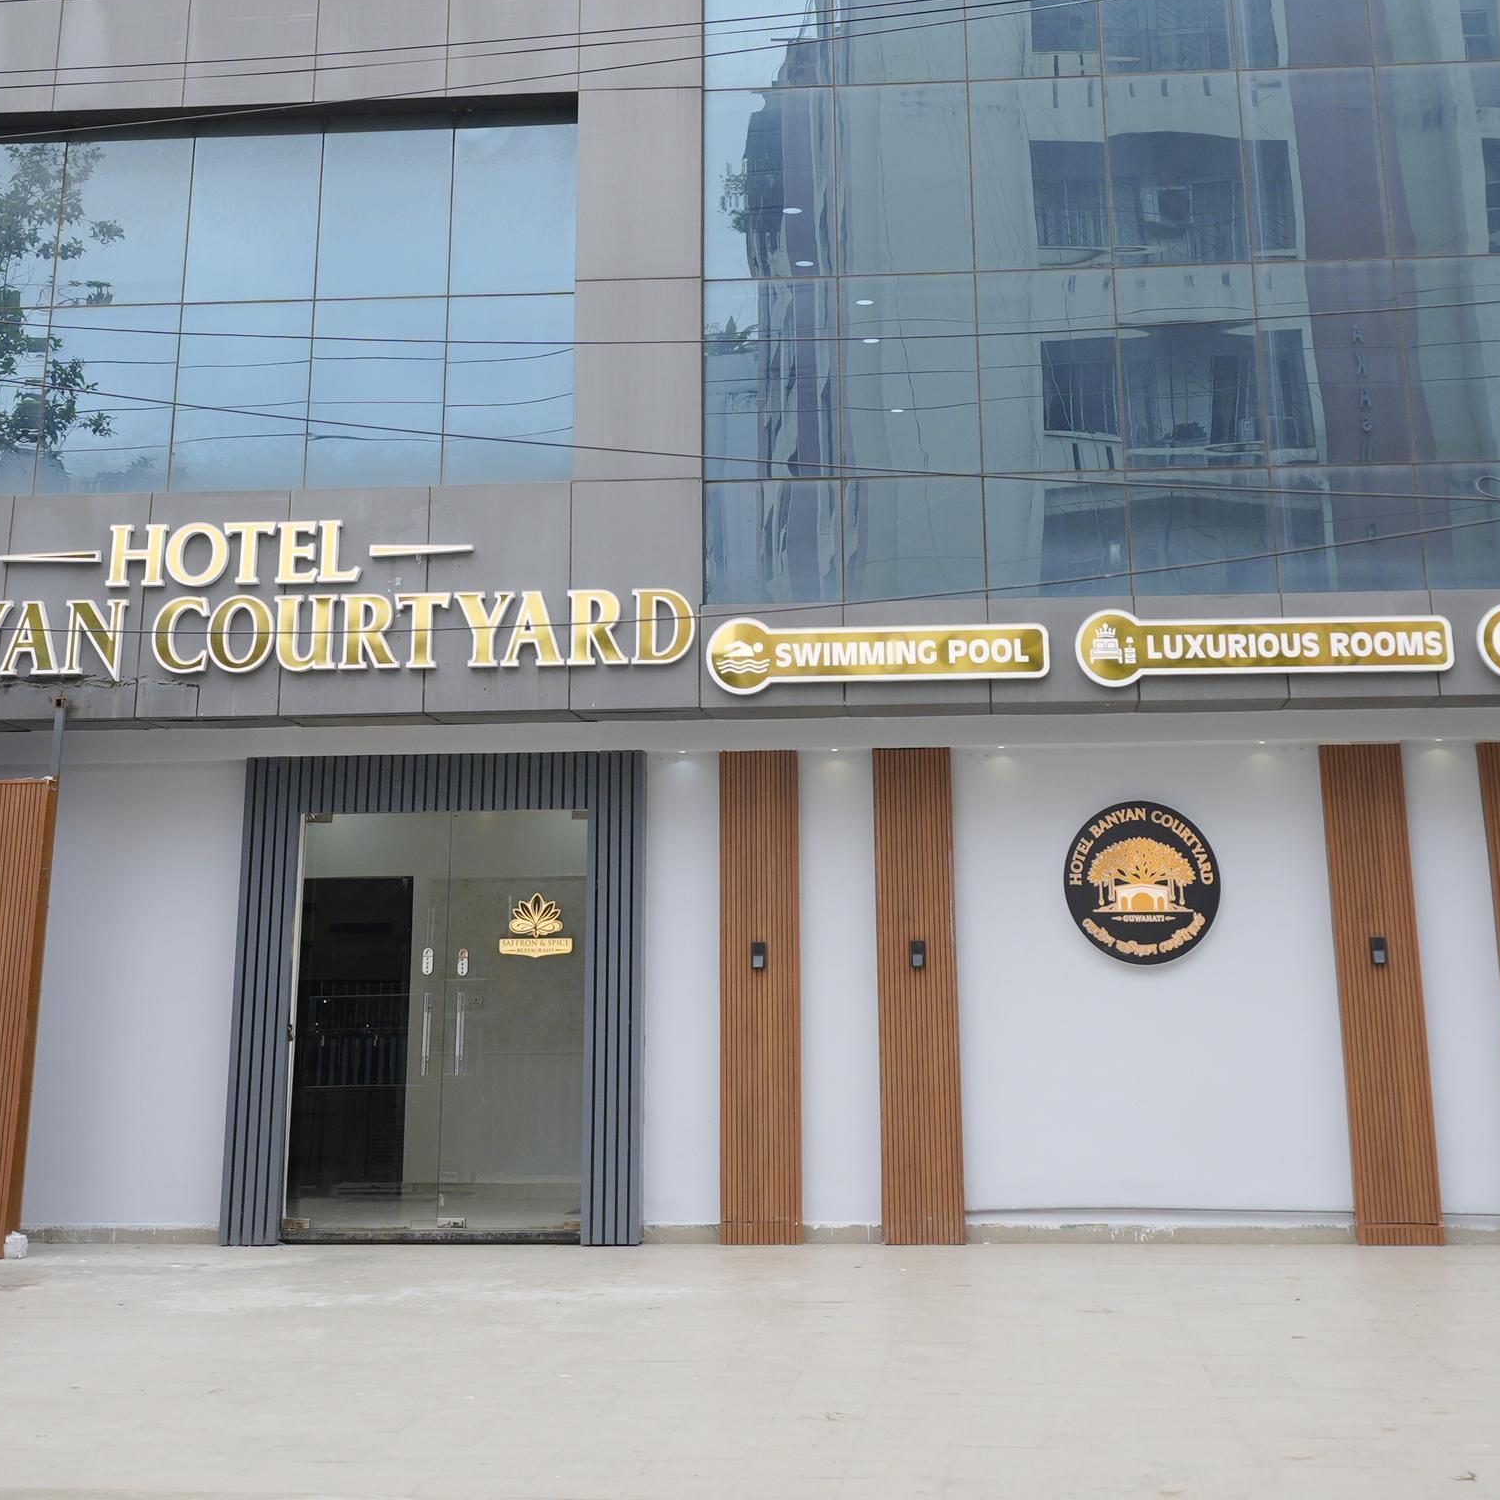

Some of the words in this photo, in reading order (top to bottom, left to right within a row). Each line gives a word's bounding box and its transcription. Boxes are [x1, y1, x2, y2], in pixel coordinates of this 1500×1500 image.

[105, 519, 362, 588] HOTEL
[150, 587, 697, 675] COURTYARD
[1146, 632, 1320, 660] LUXURIOUS
[1329, 629, 1443, 658] ROOMS
[775, 639, 938, 668] SWIMMING
[949, 637, 1030, 665] POOL
[1069, 838, 1094, 886] HOTEL
[1090, 807, 1147, 839] BANYAN
[1151, 810, 1214, 886] COURTYARD
[1123, 914, 1165, 923] GUWAHATI
[502, 939, 537, 948] SAFFRON
[547, 939, 570, 947] SPICE
